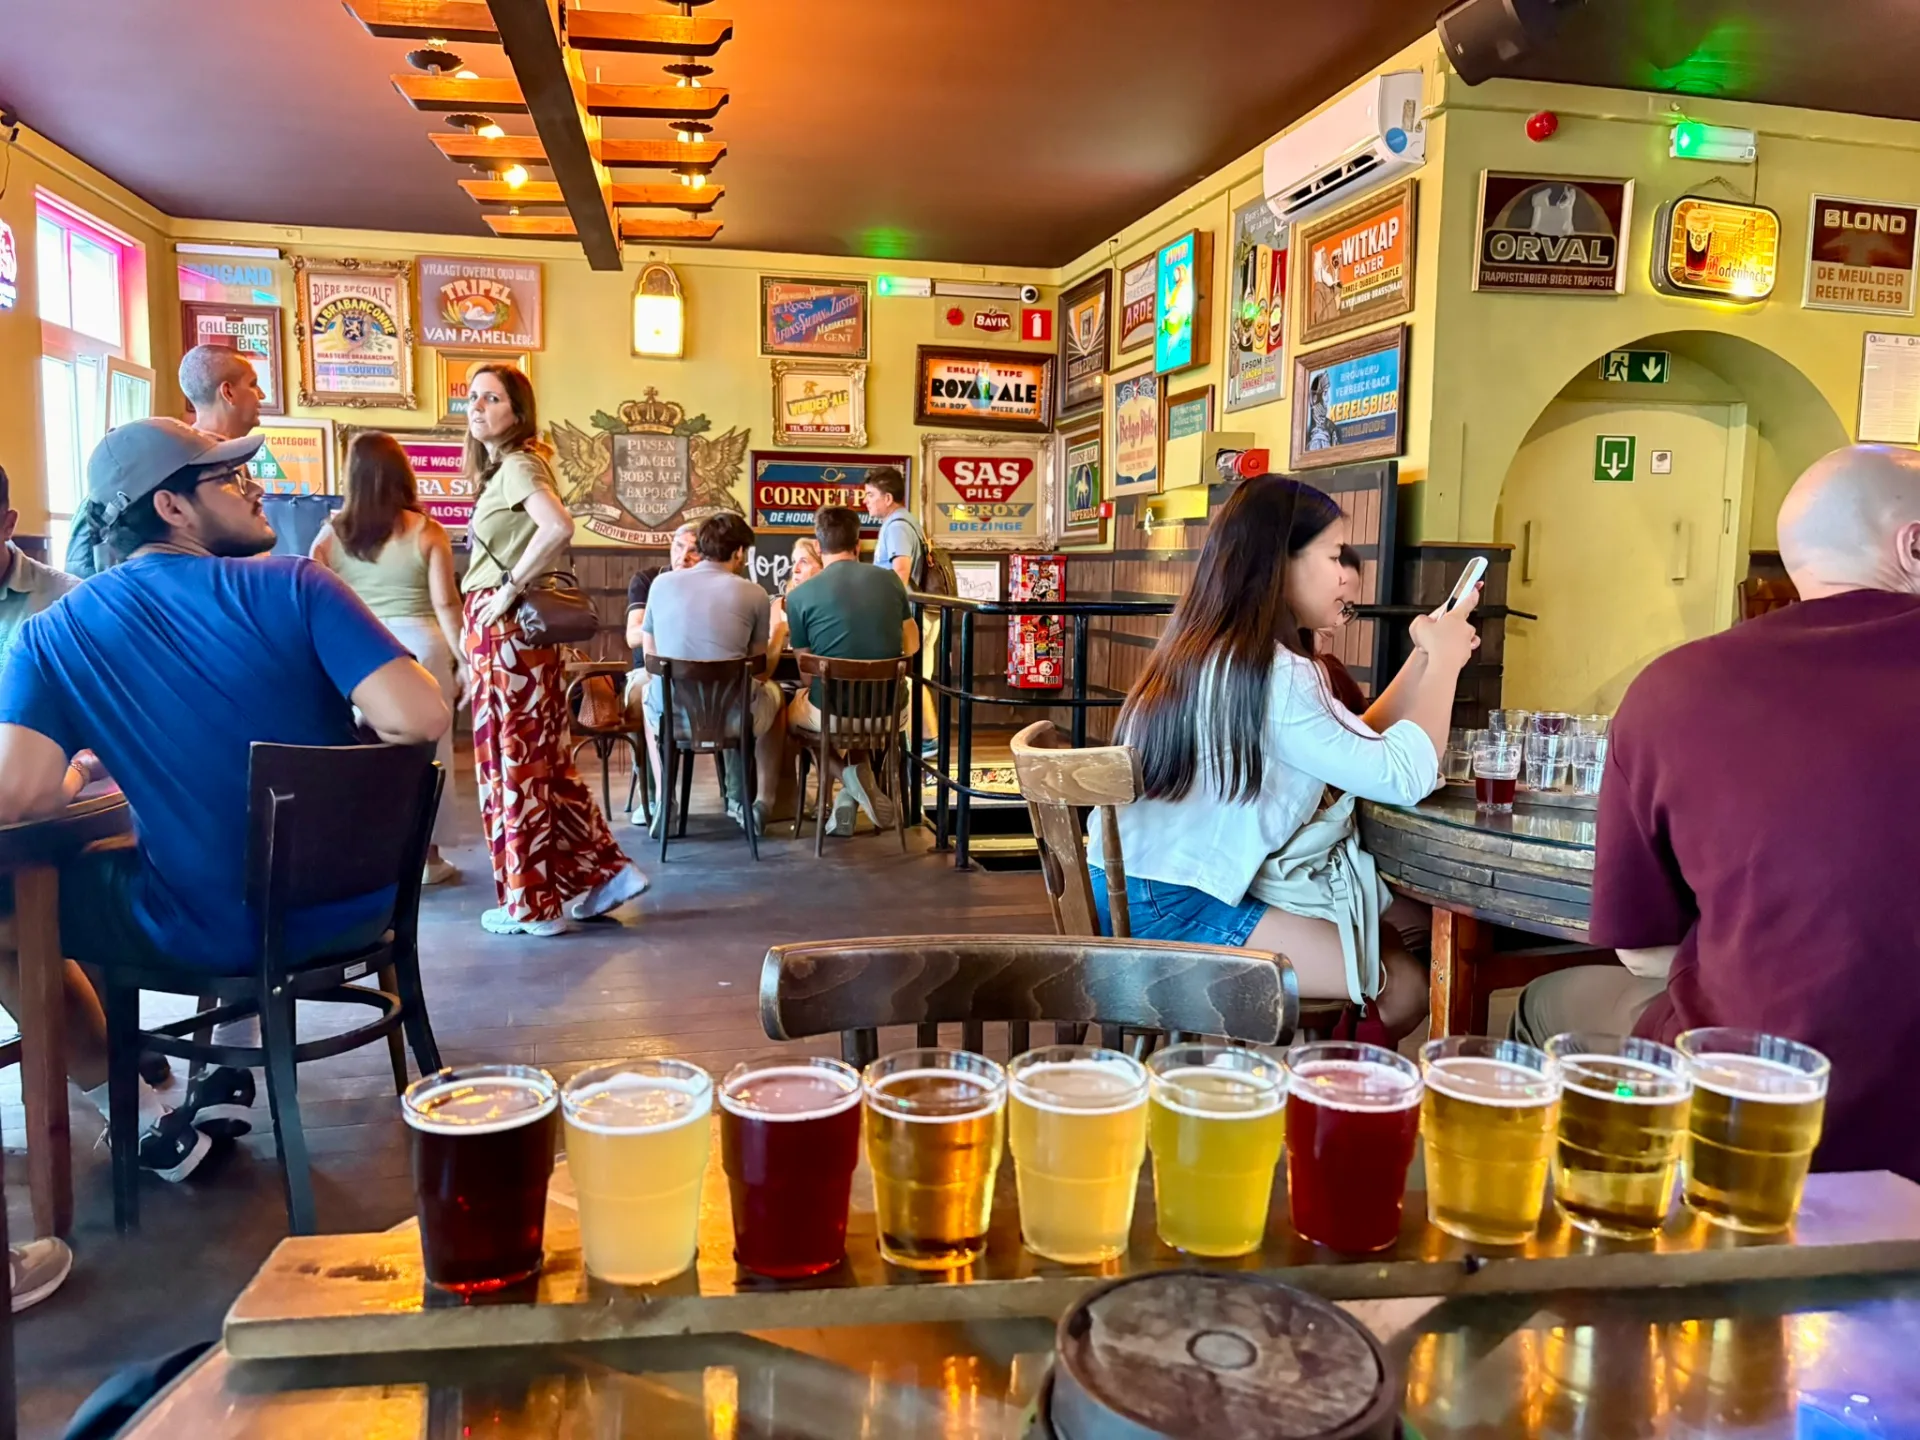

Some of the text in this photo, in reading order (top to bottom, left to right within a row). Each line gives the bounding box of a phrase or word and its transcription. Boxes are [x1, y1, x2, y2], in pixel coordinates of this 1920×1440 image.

[1824, 208, 1907, 235] BLOND
[1341, 216, 1399, 267] WITKAP
[1490, 233, 1609, 265] ORVAL
[422, 263, 461, 277] VRAAGT
[462, 266, 498, 280] OVERAL
[1354, 255, 1384, 279] PATER
[1573, 275, 1614, 287] TRAPPISTE
[1817, 267, 1904, 287] DE MEULDER
[440, 279, 512, 305] TRIPEL
[1816, 285, 1855, 301] REETH
[784, 300, 814, 313] ROOS
[321, 298, 396, 335] BRABANÇONNE
[976, 314, 1010, 328] BAVIK
[1124, 295, 1154, 336] ARDE
[199, 320, 269, 336] CALLEBAUTS
[424, 327, 457, 342] VAN
[461, 329, 508, 345] PAMEL
[823, 333, 852, 343] GENT
[238, 338, 269, 350] BIER
[996, 369, 1023, 378] TYPE
[450, 383, 468, 397] HO
[931, 378, 1037, 404] ROYAL ALE
[930, 401, 946, 409] VAN
[949, 402, 967, 410] ROY
[1329, 390, 1398, 423] KERELSBIER
[271, 436, 317, 447] CATEGORIE
[627, 439, 676, 451] PILSEN
[657, 471, 682, 483] ALE
[953, 461, 1020, 486] SAS
[450, 479, 474, 496] ST
[626, 487, 677, 500] EXPORT
[966, 487, 1003, 499] PILS
[759, 485, 866, 507] CORNET P
[634, 502, 669, 514] BOCK
[946, 503, 1023, 516] LEROY
[1069, 506, 1099, 521] IMPERIAL
[769, 511, 783, 522] DE
[949, 522, 1023, 532] BOEZINGE
